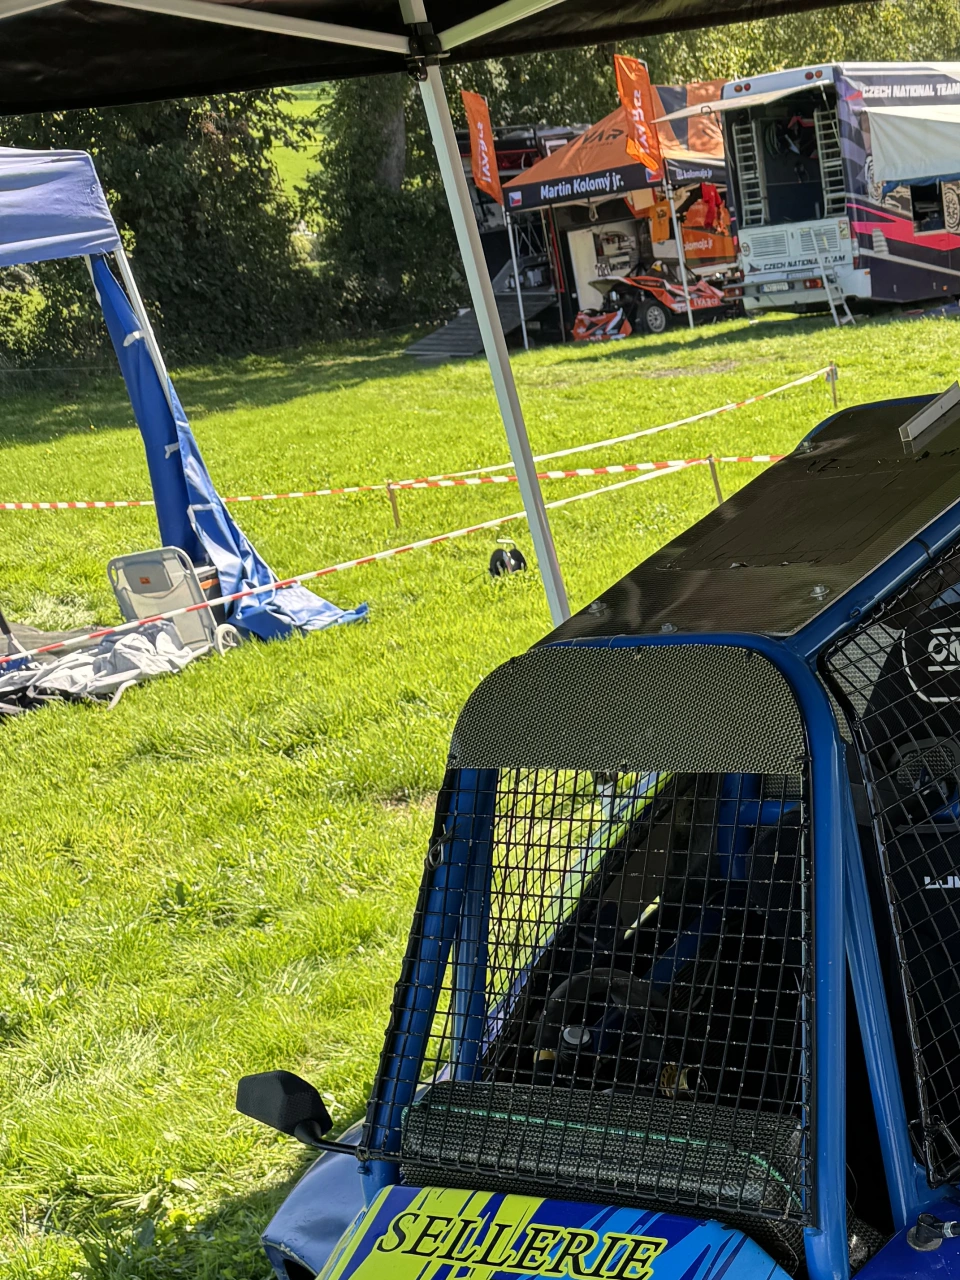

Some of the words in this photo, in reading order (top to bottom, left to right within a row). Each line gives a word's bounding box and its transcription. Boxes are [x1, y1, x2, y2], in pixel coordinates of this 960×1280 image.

[863, 85, 892, 98] CZECH
[893, 84, 934, 98] NATIONAL
[936, 82, 960, 96] TEAM
[540, 183, 571, 200] Martin
[573, 174, 610, 195] Kolomý
[611, 171, 625, 191] jr.
[763, 262, 787, 271] CZECH
[787, 257, 819, 269] NATIONA
